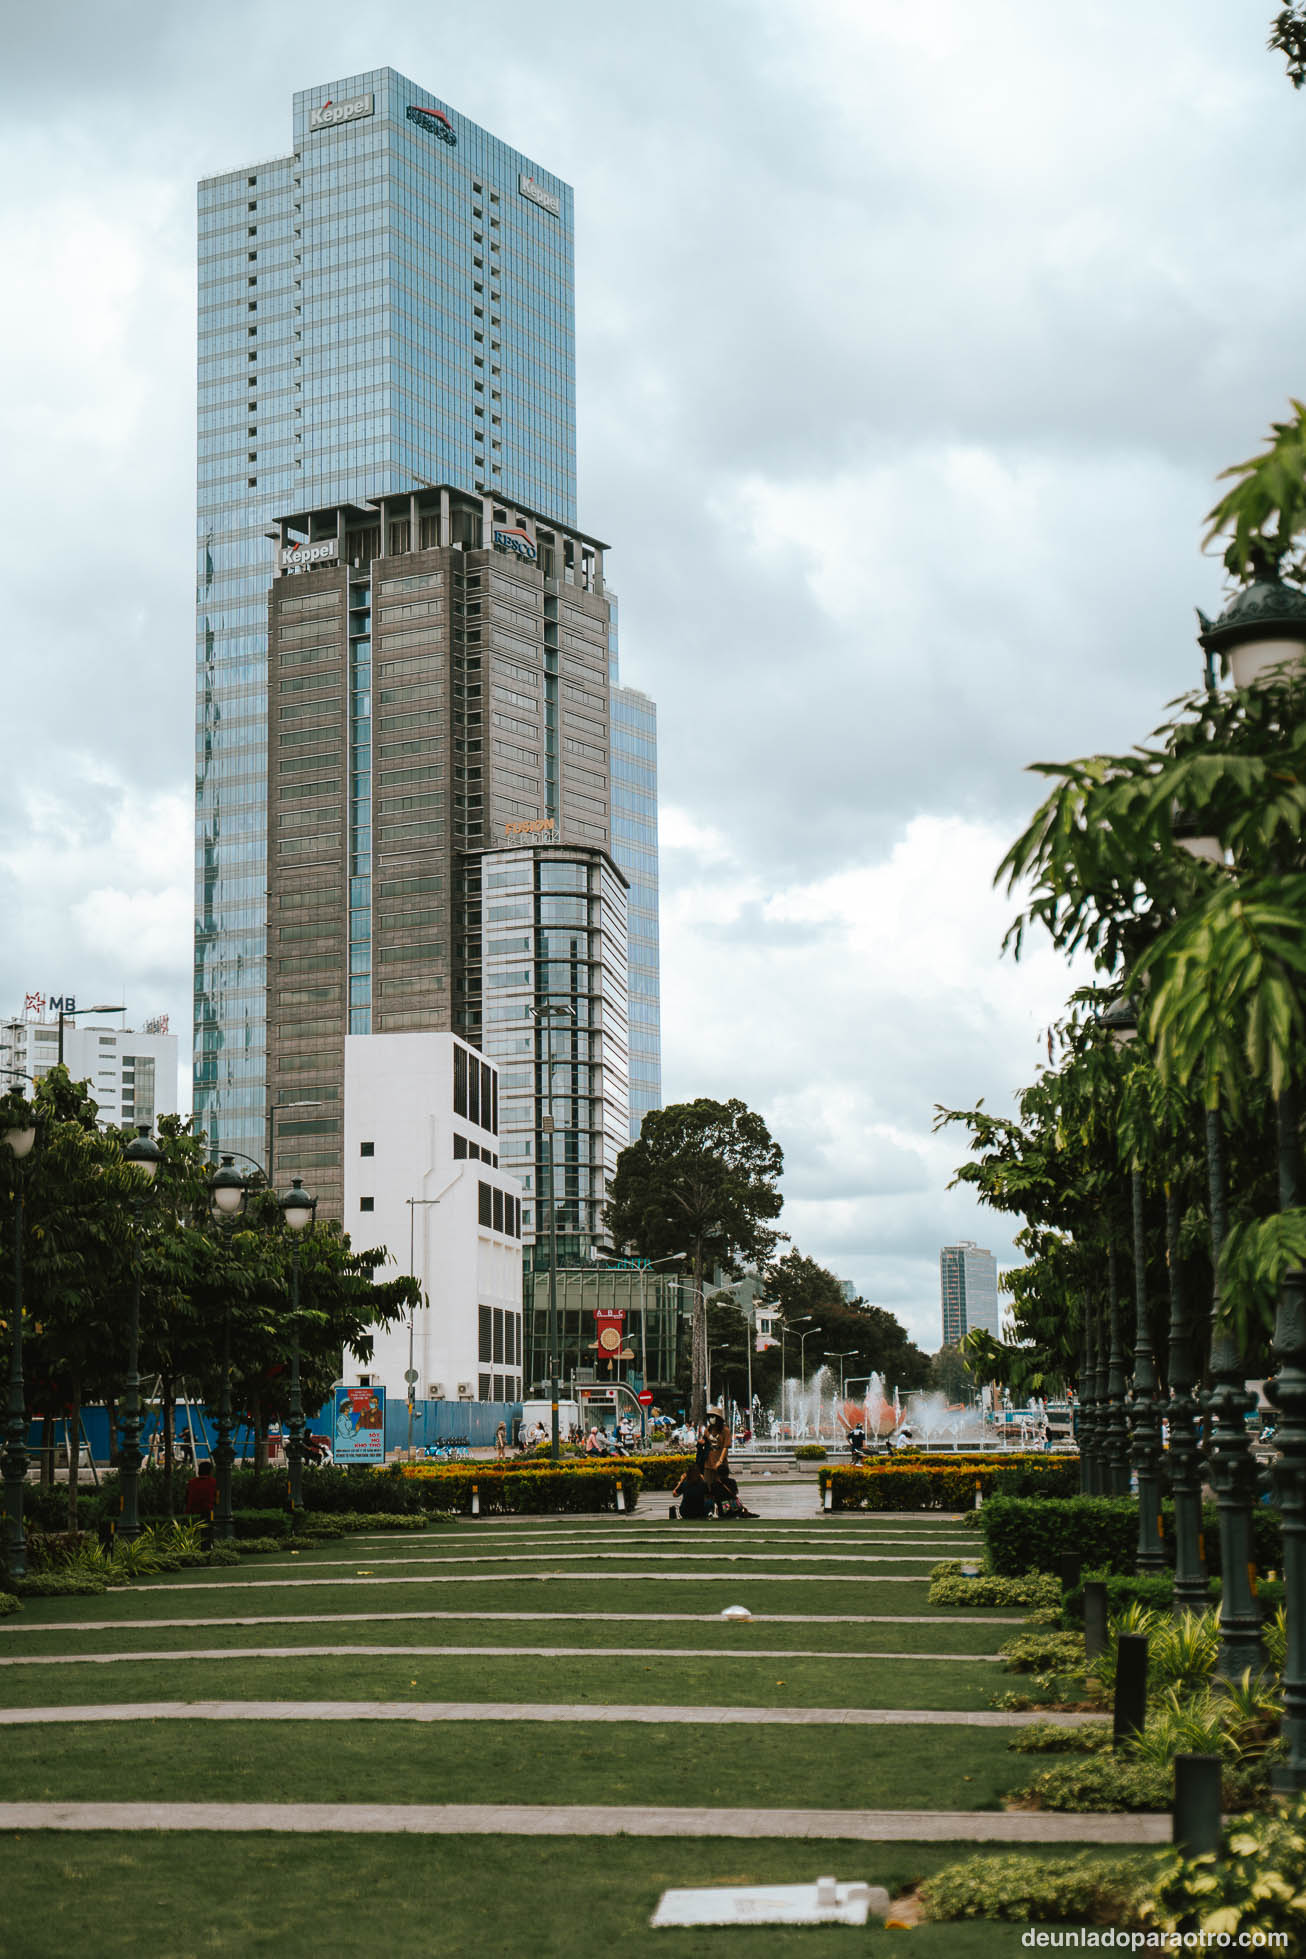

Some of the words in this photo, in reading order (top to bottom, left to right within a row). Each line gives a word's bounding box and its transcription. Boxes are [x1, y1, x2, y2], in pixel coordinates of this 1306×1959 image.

[311, 95, 369, 126] Keppel
[521, 175, 560, 212] Keppel
[282, 541, 334, 565] Keppel
[494, 530, 537, 558] RESCO
[504, 818, 555, 835] FUSION
[49, 996, 76, 1011] MB
